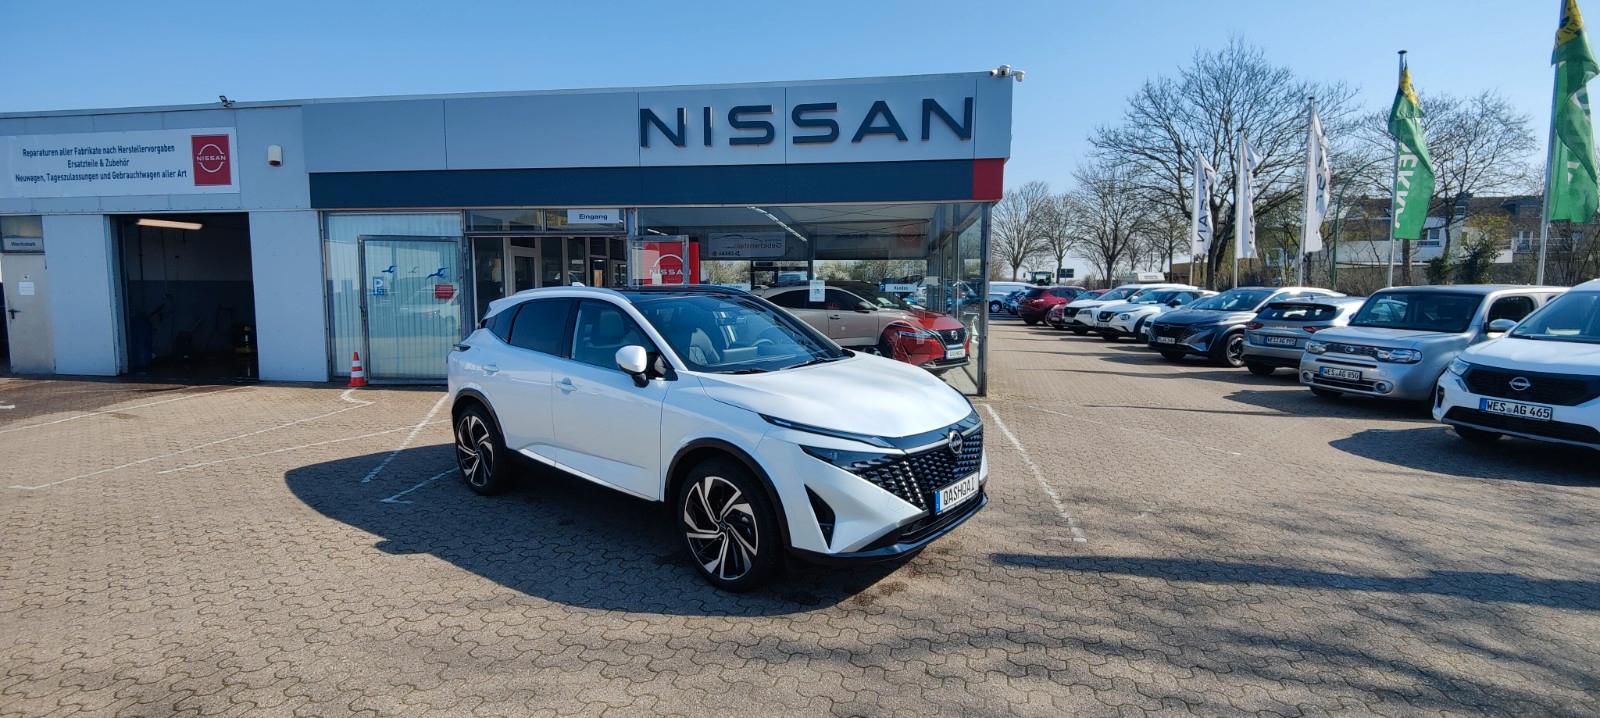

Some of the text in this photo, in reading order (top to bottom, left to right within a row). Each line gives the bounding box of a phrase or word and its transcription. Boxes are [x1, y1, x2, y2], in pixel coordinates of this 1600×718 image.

[639, 97, 974, 147] NISSAN
[22, 144, 175, 158] Reparaturen aller Fabrikate nach Herstellervorgaben
[67, 158, 130, 168] Ersatzteile & Zubehör
[15, 169, 187, 183] Neuwagen, Tageszulassungen und Gebrauchtwagen aller Art
[578, 213, 608, 221] Eingang
[650, 268, 691, 276] NISSA
[1487, 400, 1550, 418] WES AG 465
[943, 476, 975, 505] QASHQAI
